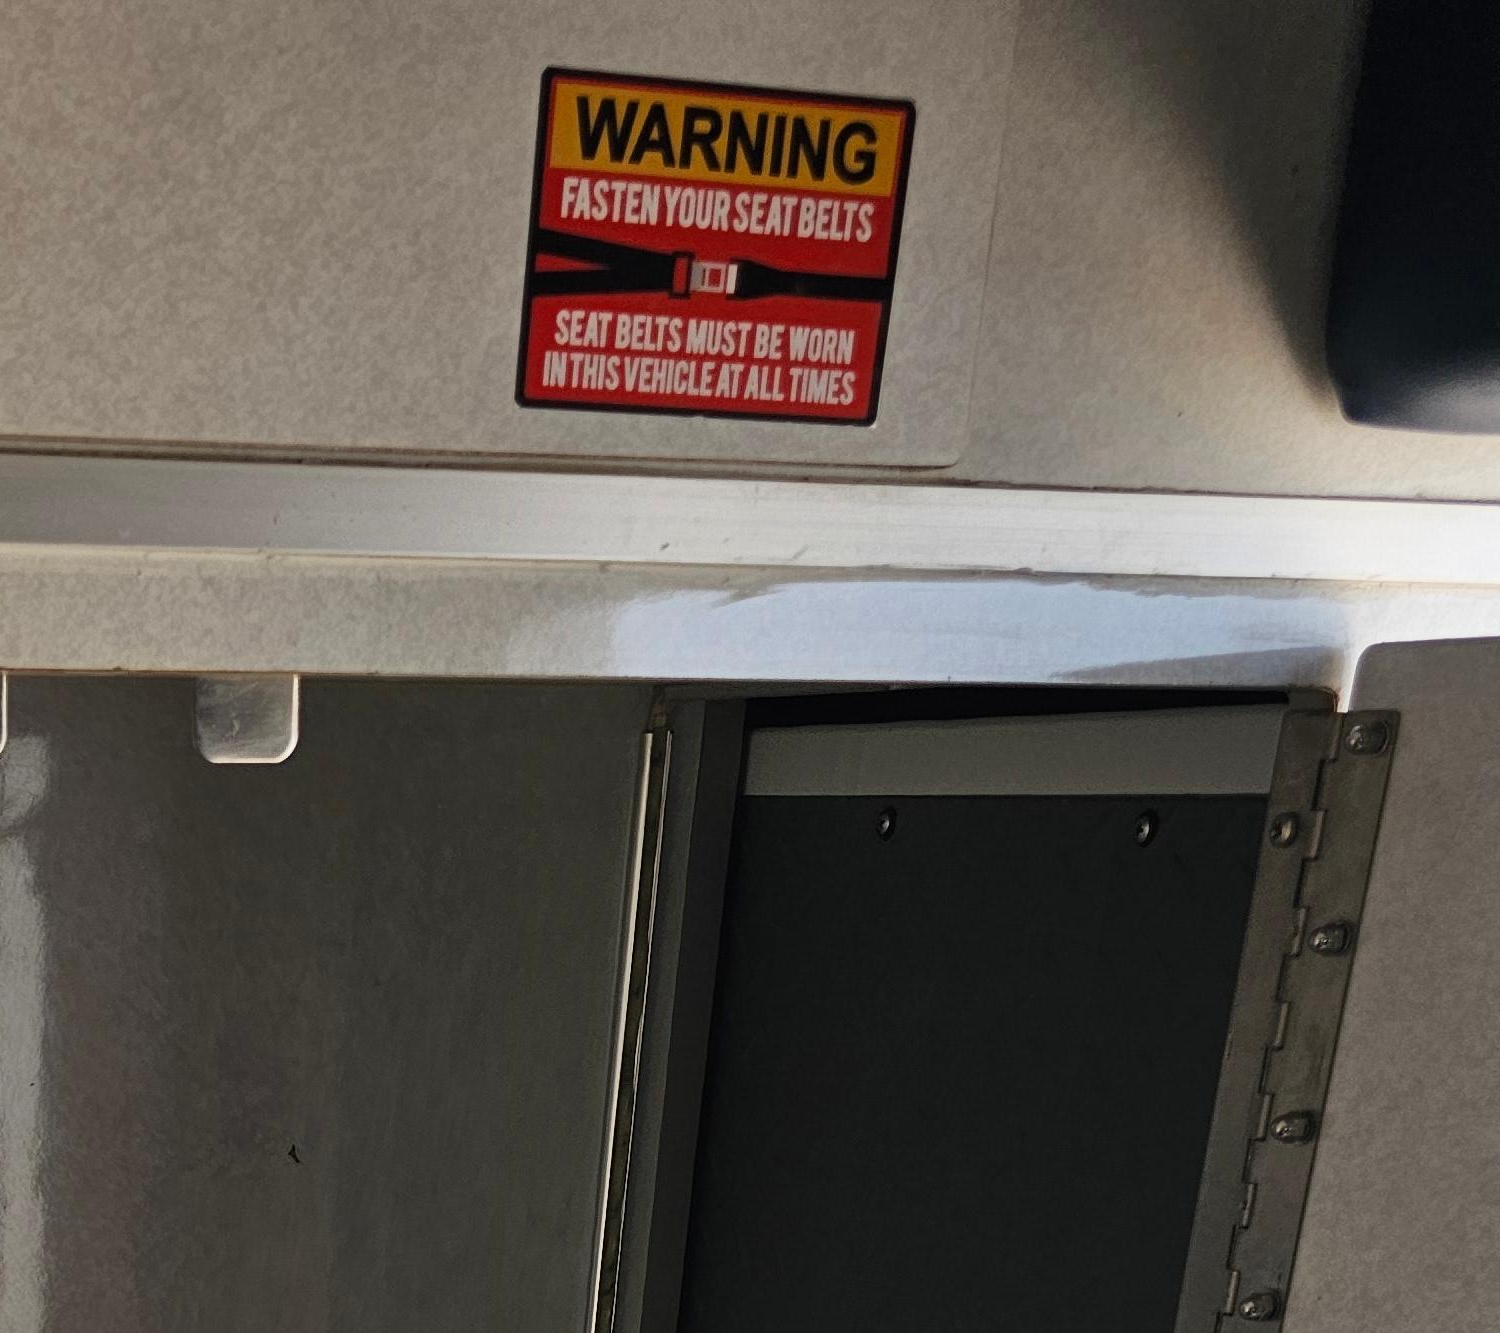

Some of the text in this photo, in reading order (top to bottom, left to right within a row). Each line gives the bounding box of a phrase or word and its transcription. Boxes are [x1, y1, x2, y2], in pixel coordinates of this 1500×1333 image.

[577, 95, 877, 185] WARNING
[560, 176, 875, 242] FASTEN YOUR SEAT BELTS
[555, 309, 855, 364] SEAT BELTS MUST BE WORN
[542, 352, 856, 405] IN THIS VEHICLE AT ALL TIMES
